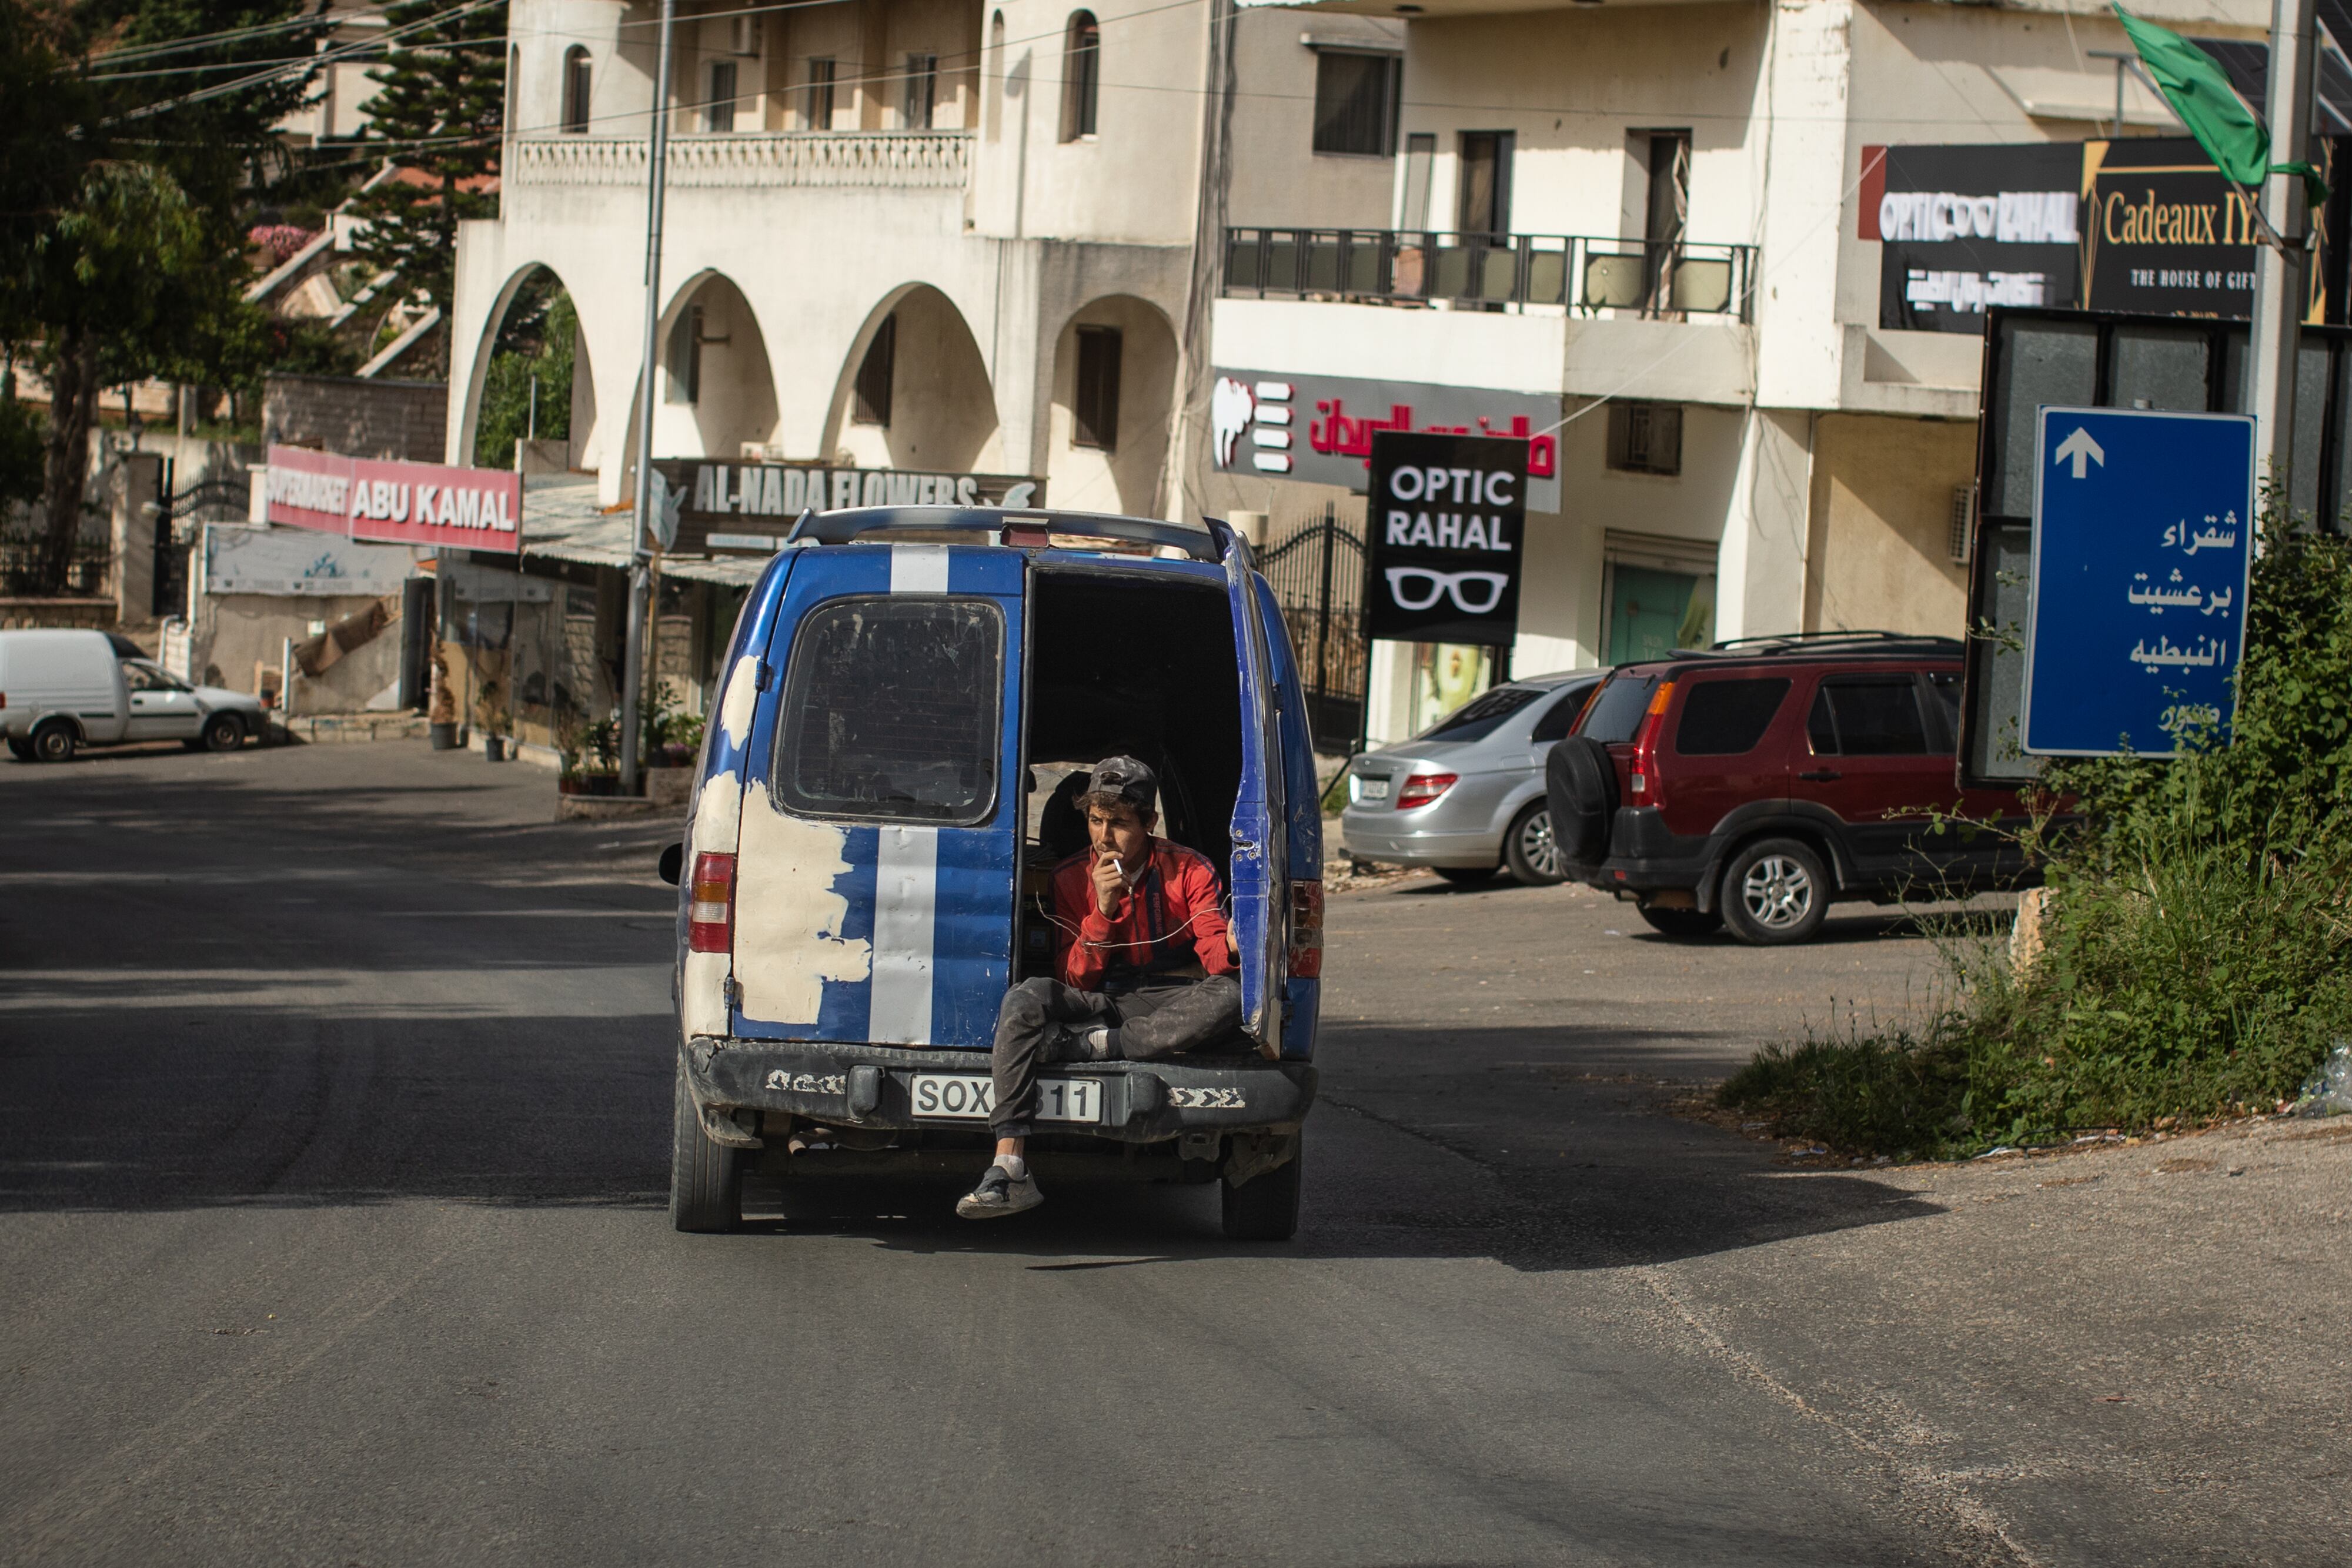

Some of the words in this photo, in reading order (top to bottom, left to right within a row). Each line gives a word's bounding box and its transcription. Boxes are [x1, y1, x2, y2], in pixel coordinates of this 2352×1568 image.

[1879, 192, 1957, 242] OPTIC
[1996, 192, 2080, 243] RAHAL
[2104, 189, 2217, 245] Cadeaux
[2223, 192, 2259, 245] IY
[2131, 269, 2155, 287] THE
[2159, 269, 2200, 288] HOUSE
[2205, 270, 2222, 289] OF
[353, 479, 409, 523] ABU
[416, 485, 516, 532] KAMAL
[693, 464, 827, 517] AL-NADA
[1389, 465, 1516, 506] OPTIC
[1386, 510, 1512, 551] RAHAL
[2160, 510, 2237, 556] شقراء
[2128, 568, 2232, 618] برعشيت
[1152, 892, 1163, 938] PERFORMANC
[918, 1079, 991, 1112] SOX
